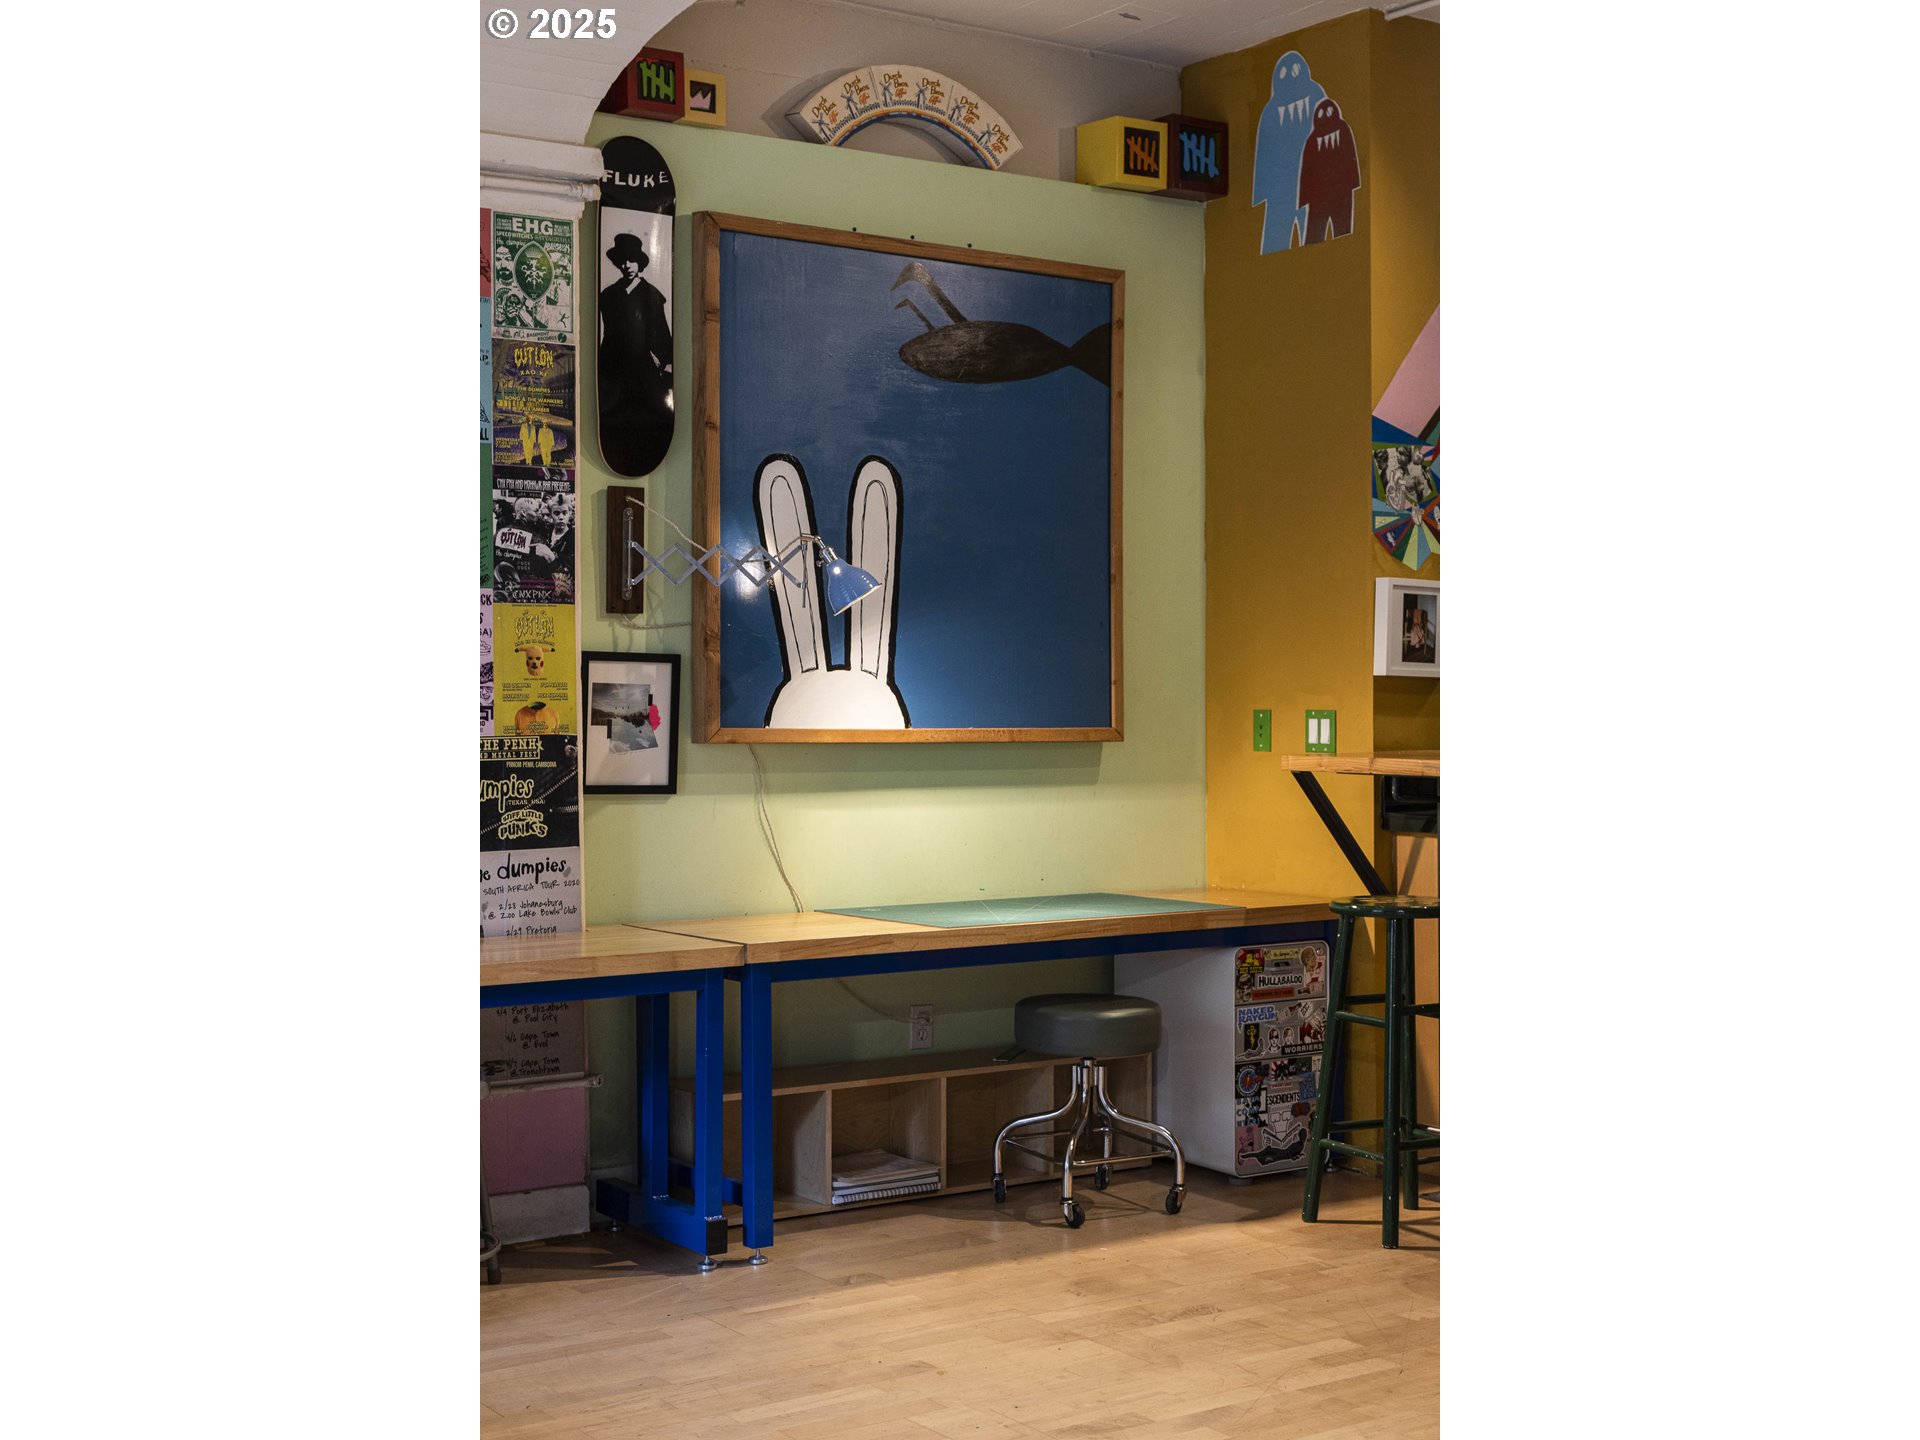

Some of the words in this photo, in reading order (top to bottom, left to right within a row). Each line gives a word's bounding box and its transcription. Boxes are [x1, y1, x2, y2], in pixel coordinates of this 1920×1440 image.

[602, 169, 669, 188] FLUKE
[512, 217, 553, 236] EHG
[504, 738, 537, 750] PENH
[498, 820, 548, 839] PUNKS
[497, 853, 566, 884] dumpies
[483, 886, 504, 896] SOUTH
[508, 883, 534, 893] AFRICA
[540, 880, 560, 889] TOUR
[563, 879, 580, 887] 2020
[519, 909, 537, 917] Lake
[563, 905, 578, 914] Club
[1259, 976, 1302, 987] HULLABALOO
[511, 1006, 528, 1015] Port
[1238, 1006, 1274, 1017] NAKED
[525, 1014, 539, 1023] Pool
[542, 1014, 557, 1023] City
[1239, 1012, 1277, 1024] RAYGUN
[1284, 1044, 1323, 1054] WORRIERS
